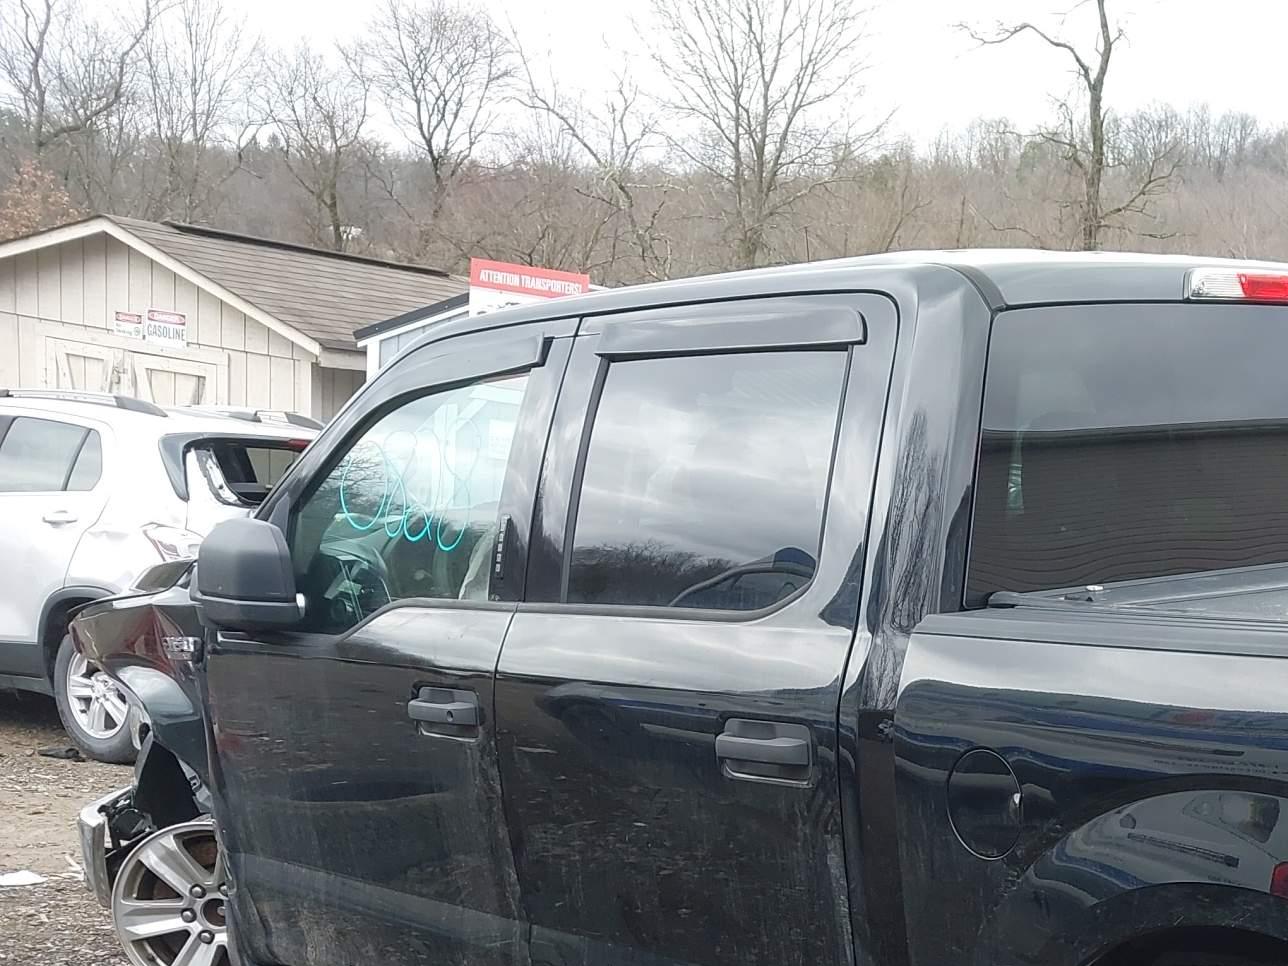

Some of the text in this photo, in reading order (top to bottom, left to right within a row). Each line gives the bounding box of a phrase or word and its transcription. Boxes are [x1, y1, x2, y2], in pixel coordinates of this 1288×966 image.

[480, 269, 582, 295] ATTENTION TRANSPORTERS!
[147, 323, 186, 341] GASOLINE
